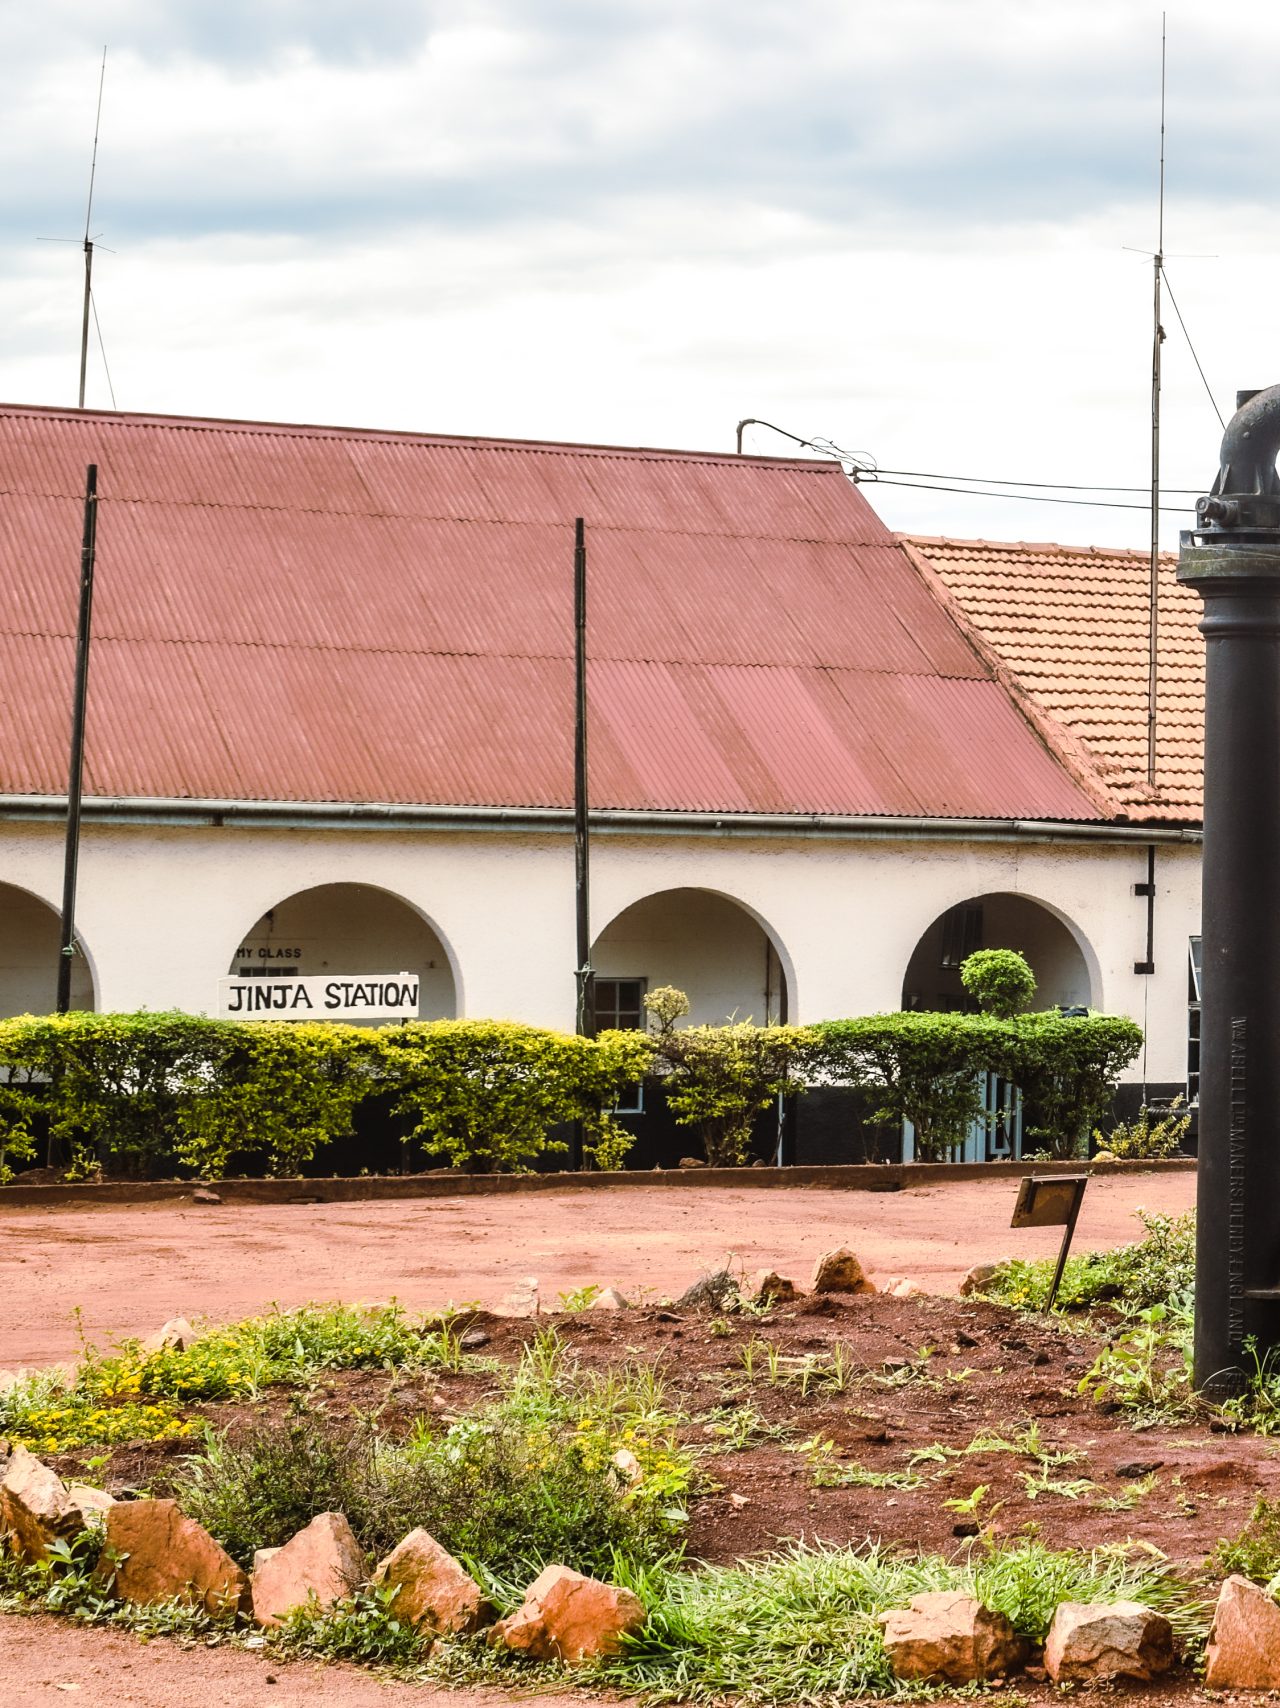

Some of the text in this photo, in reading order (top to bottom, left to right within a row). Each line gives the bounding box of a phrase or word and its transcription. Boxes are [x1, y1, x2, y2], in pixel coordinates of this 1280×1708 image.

[258, 947, 302, 959] CLASS
[228, 982, 419, 1012] JINJA STATION
